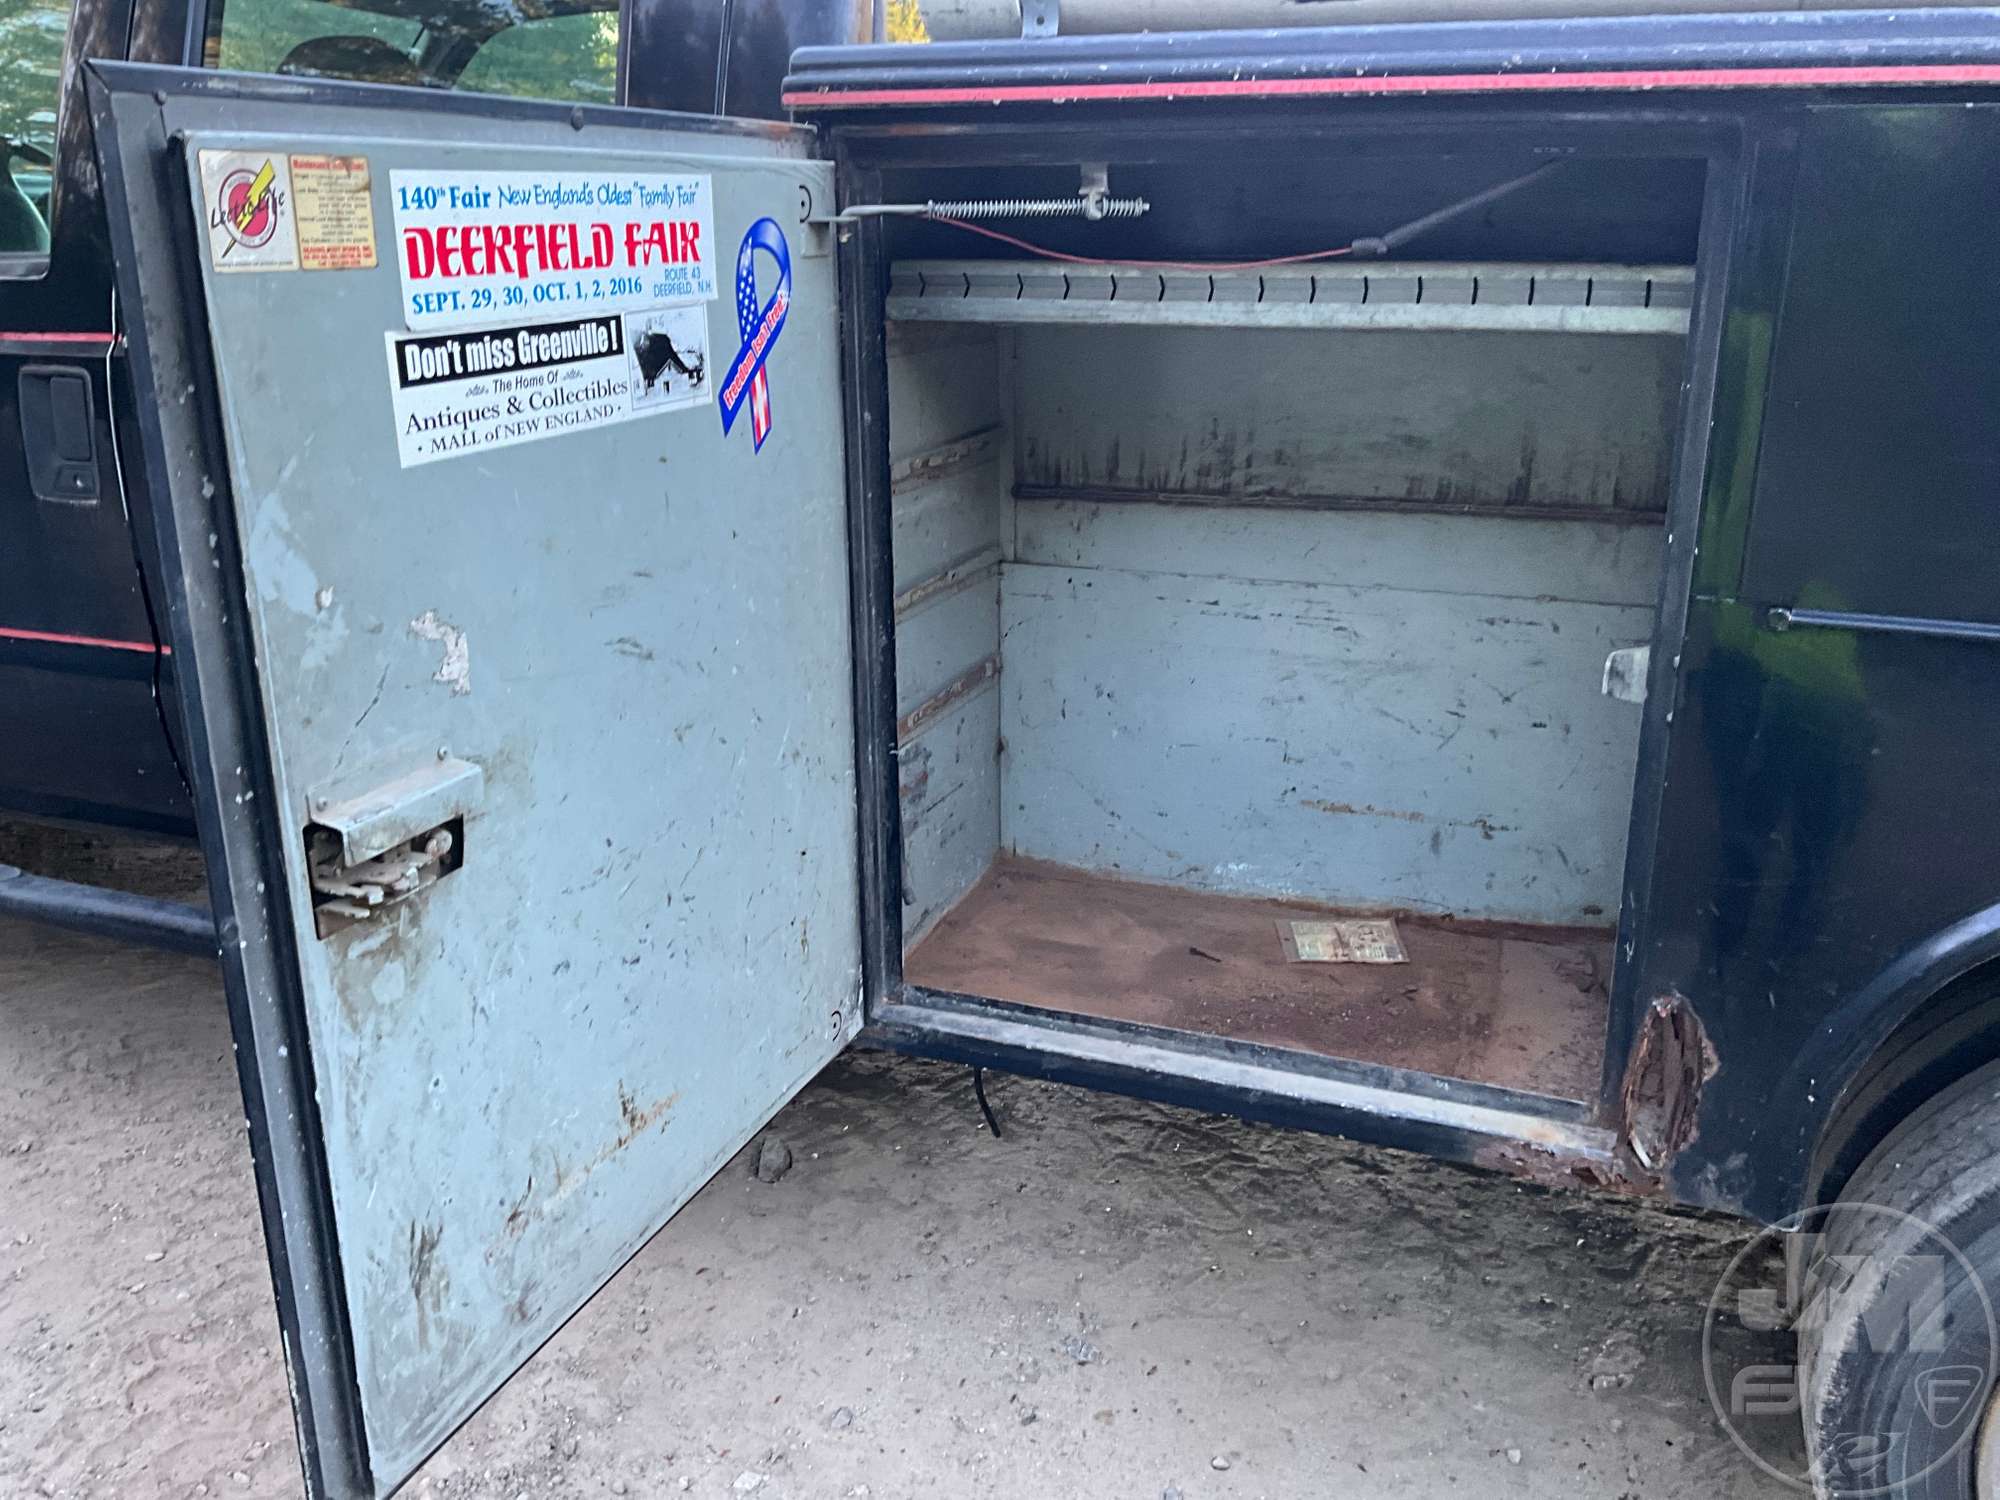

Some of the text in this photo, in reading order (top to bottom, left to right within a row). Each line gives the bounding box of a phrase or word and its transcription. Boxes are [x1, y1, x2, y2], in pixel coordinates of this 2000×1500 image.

[399, 185, 446, 210] 140th
[449, 184, 491, 209] Fair
[499, 184, 531, 209] New
[533, 182, 593, 209] England's
[598, 182, 632, 206] Oldest
[633, 181, 675, 209] "Family
[676, 182, 699, 208] Fair"
[403, 221, 701, 280] DEERFIELD FAIR
[412, 277, 642, 315] SEPT. 29, 30, OCT. 1, 2, 2016
[653, 281, 695, 298] DEERFIELD,
[664, 268, 688, 281] ROUTE
[404, 340, 463, 381] Don't
[465, 335, 516, 373] miss
[517, 321, 608, 365] Greenville
[493, 368, 560, 394] The Home Of
[724, 350, 756, 411] Freedom
[406, 378, 629, 435] Antiques & Collectibles
[430, 403, 614, 453] MALL of NEW ENGLAND
